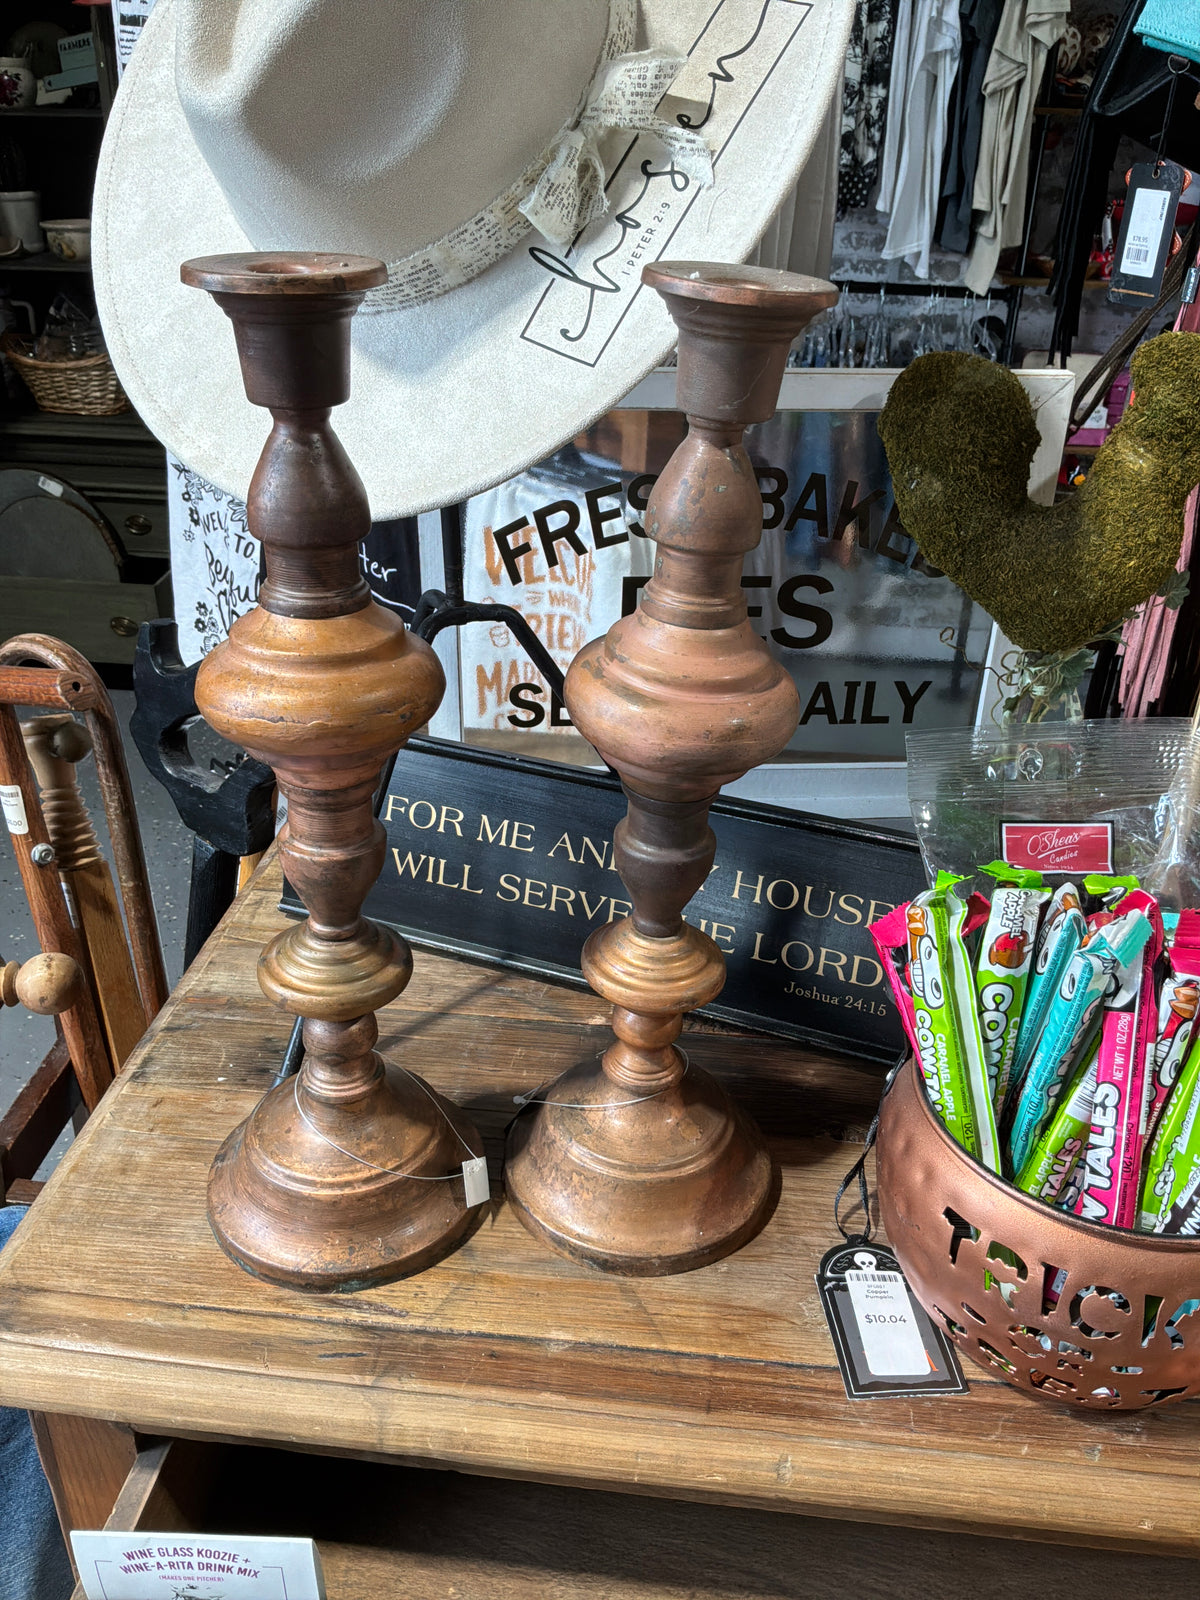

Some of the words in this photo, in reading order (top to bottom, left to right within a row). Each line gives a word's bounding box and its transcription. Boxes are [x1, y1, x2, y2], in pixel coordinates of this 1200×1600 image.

[626, 227, 657, 267] PETER
[654, 202, 672, 224] 2:9
[492, 473, 660, 587] FRES
[755, 466, 946, 578] BAKE
[798, 680, 933, 726] AILY
[383, 794, 465, 837] FOR
[476, 814, 537, 853] ME
[1049, 850, 1080, 865] Candies
[391, 847, 484, 895] WILL
[496, 873, 634, 924] SERVE
[1000, 891, 1018, 932] APPLE
[783, 981, 842, 1006] Joshua
[843, 995, 888, 1018] 24:15
[935, 1032, 952, 1088] CARAMEL
[998, 1016, 1021, 1091] CARAMEL
[1112, 1063, 1124, 1081] NET
[1113, 1052, 1125, 1065] WT
[942, 1088, 957, 1122] APPLE
[1020, 1117, 1034, 1143] Calories
[1085, 1081, 1122, 1190] TALES
[1125, 1122, 1135, 1153] Calories
[1040, 1137, 1083, 1198] TALES
[1122, 1154, 1134, 1174] 120
[942, 1205, 1200, 1350] TRICK
[864, 1313, 908, 1324] $10.04
[119, 1560, 195, 1575] WINE-A-RITA
[198, 1561, 235, 1575] DRINK
[236, 1566, 262, 1580] MIX
[121, 1547, 157, 1562] WINE
[157, 1546, 194, 1558] GLASS
[197, 1548, 241, 1564] KOOZIE
